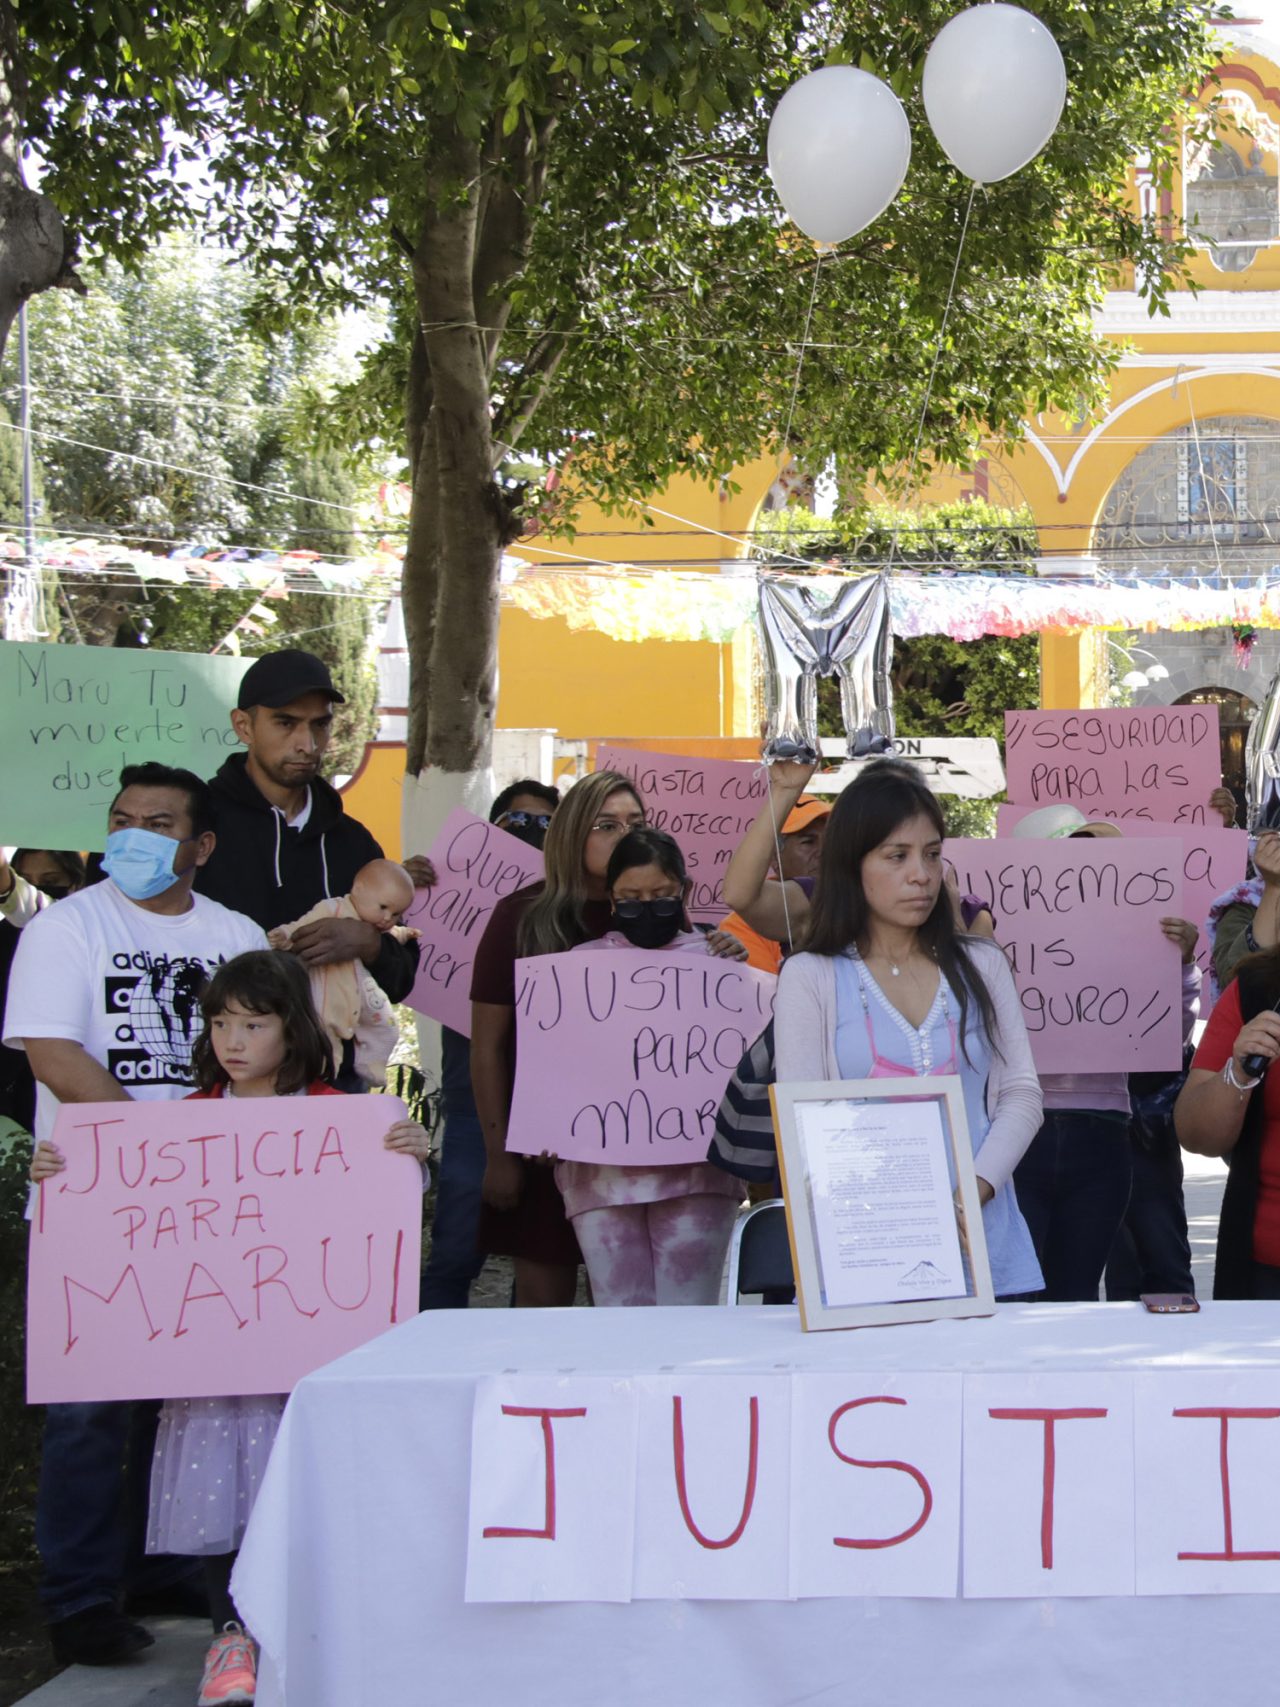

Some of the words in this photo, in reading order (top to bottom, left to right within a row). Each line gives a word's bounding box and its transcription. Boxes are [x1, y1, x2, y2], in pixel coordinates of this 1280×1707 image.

[130, 669, 187, 707] Tu
[29, 708, 187, 744] muerte
[200, 726, 249, 748] no
[894, 739, 921, 755] ON
[1002, 938, 1076, 976] AIS
[112, 1194, 266, 1251] PARA
